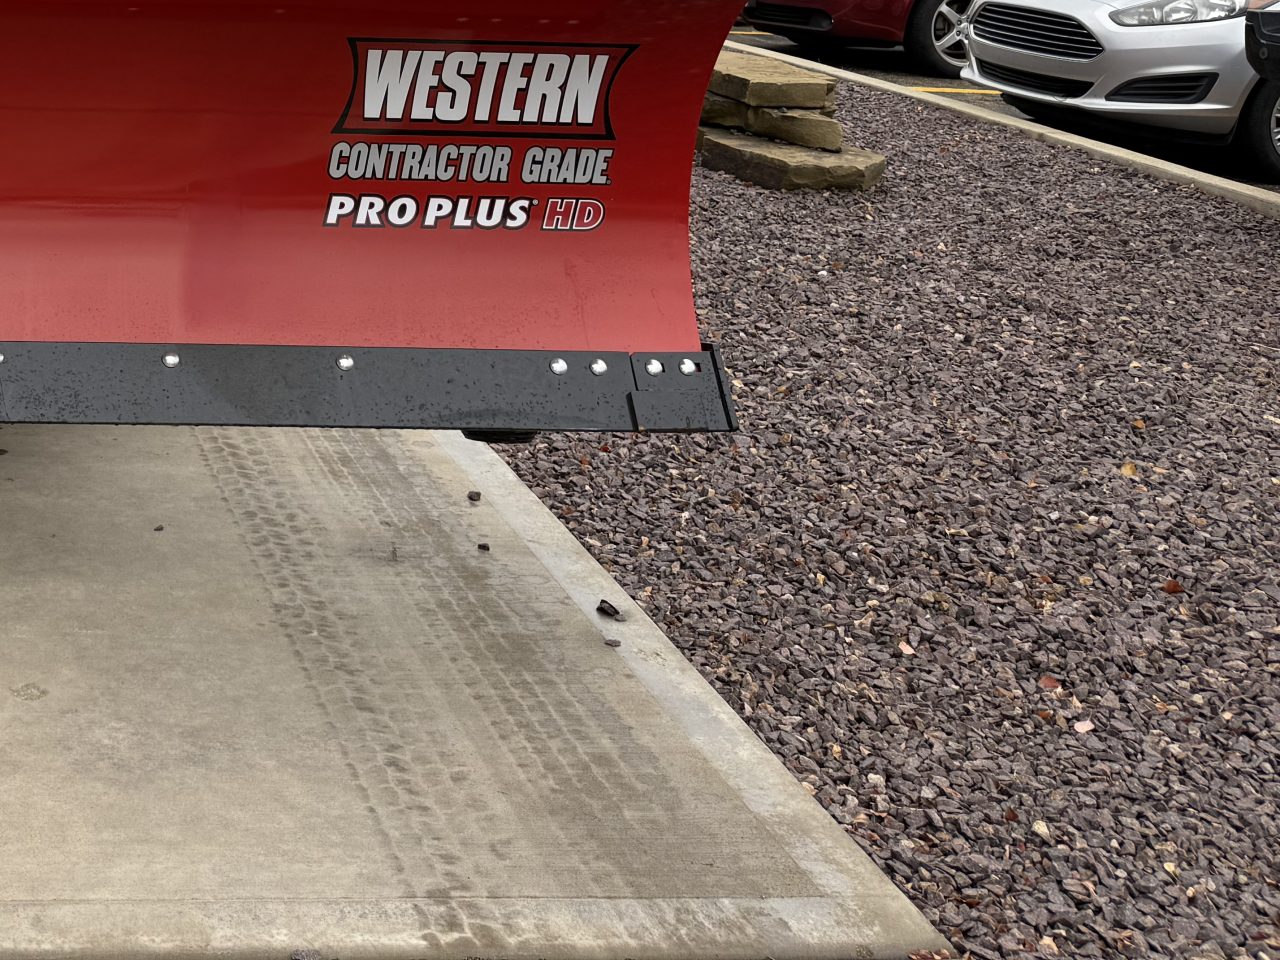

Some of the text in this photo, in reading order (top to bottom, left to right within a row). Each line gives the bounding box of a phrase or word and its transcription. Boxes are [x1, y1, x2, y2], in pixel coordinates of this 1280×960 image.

[363, 49, 610, 124] WESTERN
[328, 141, 614, 184] CONTRACTOR GRADE
[542, 198, 606, 231] HD
